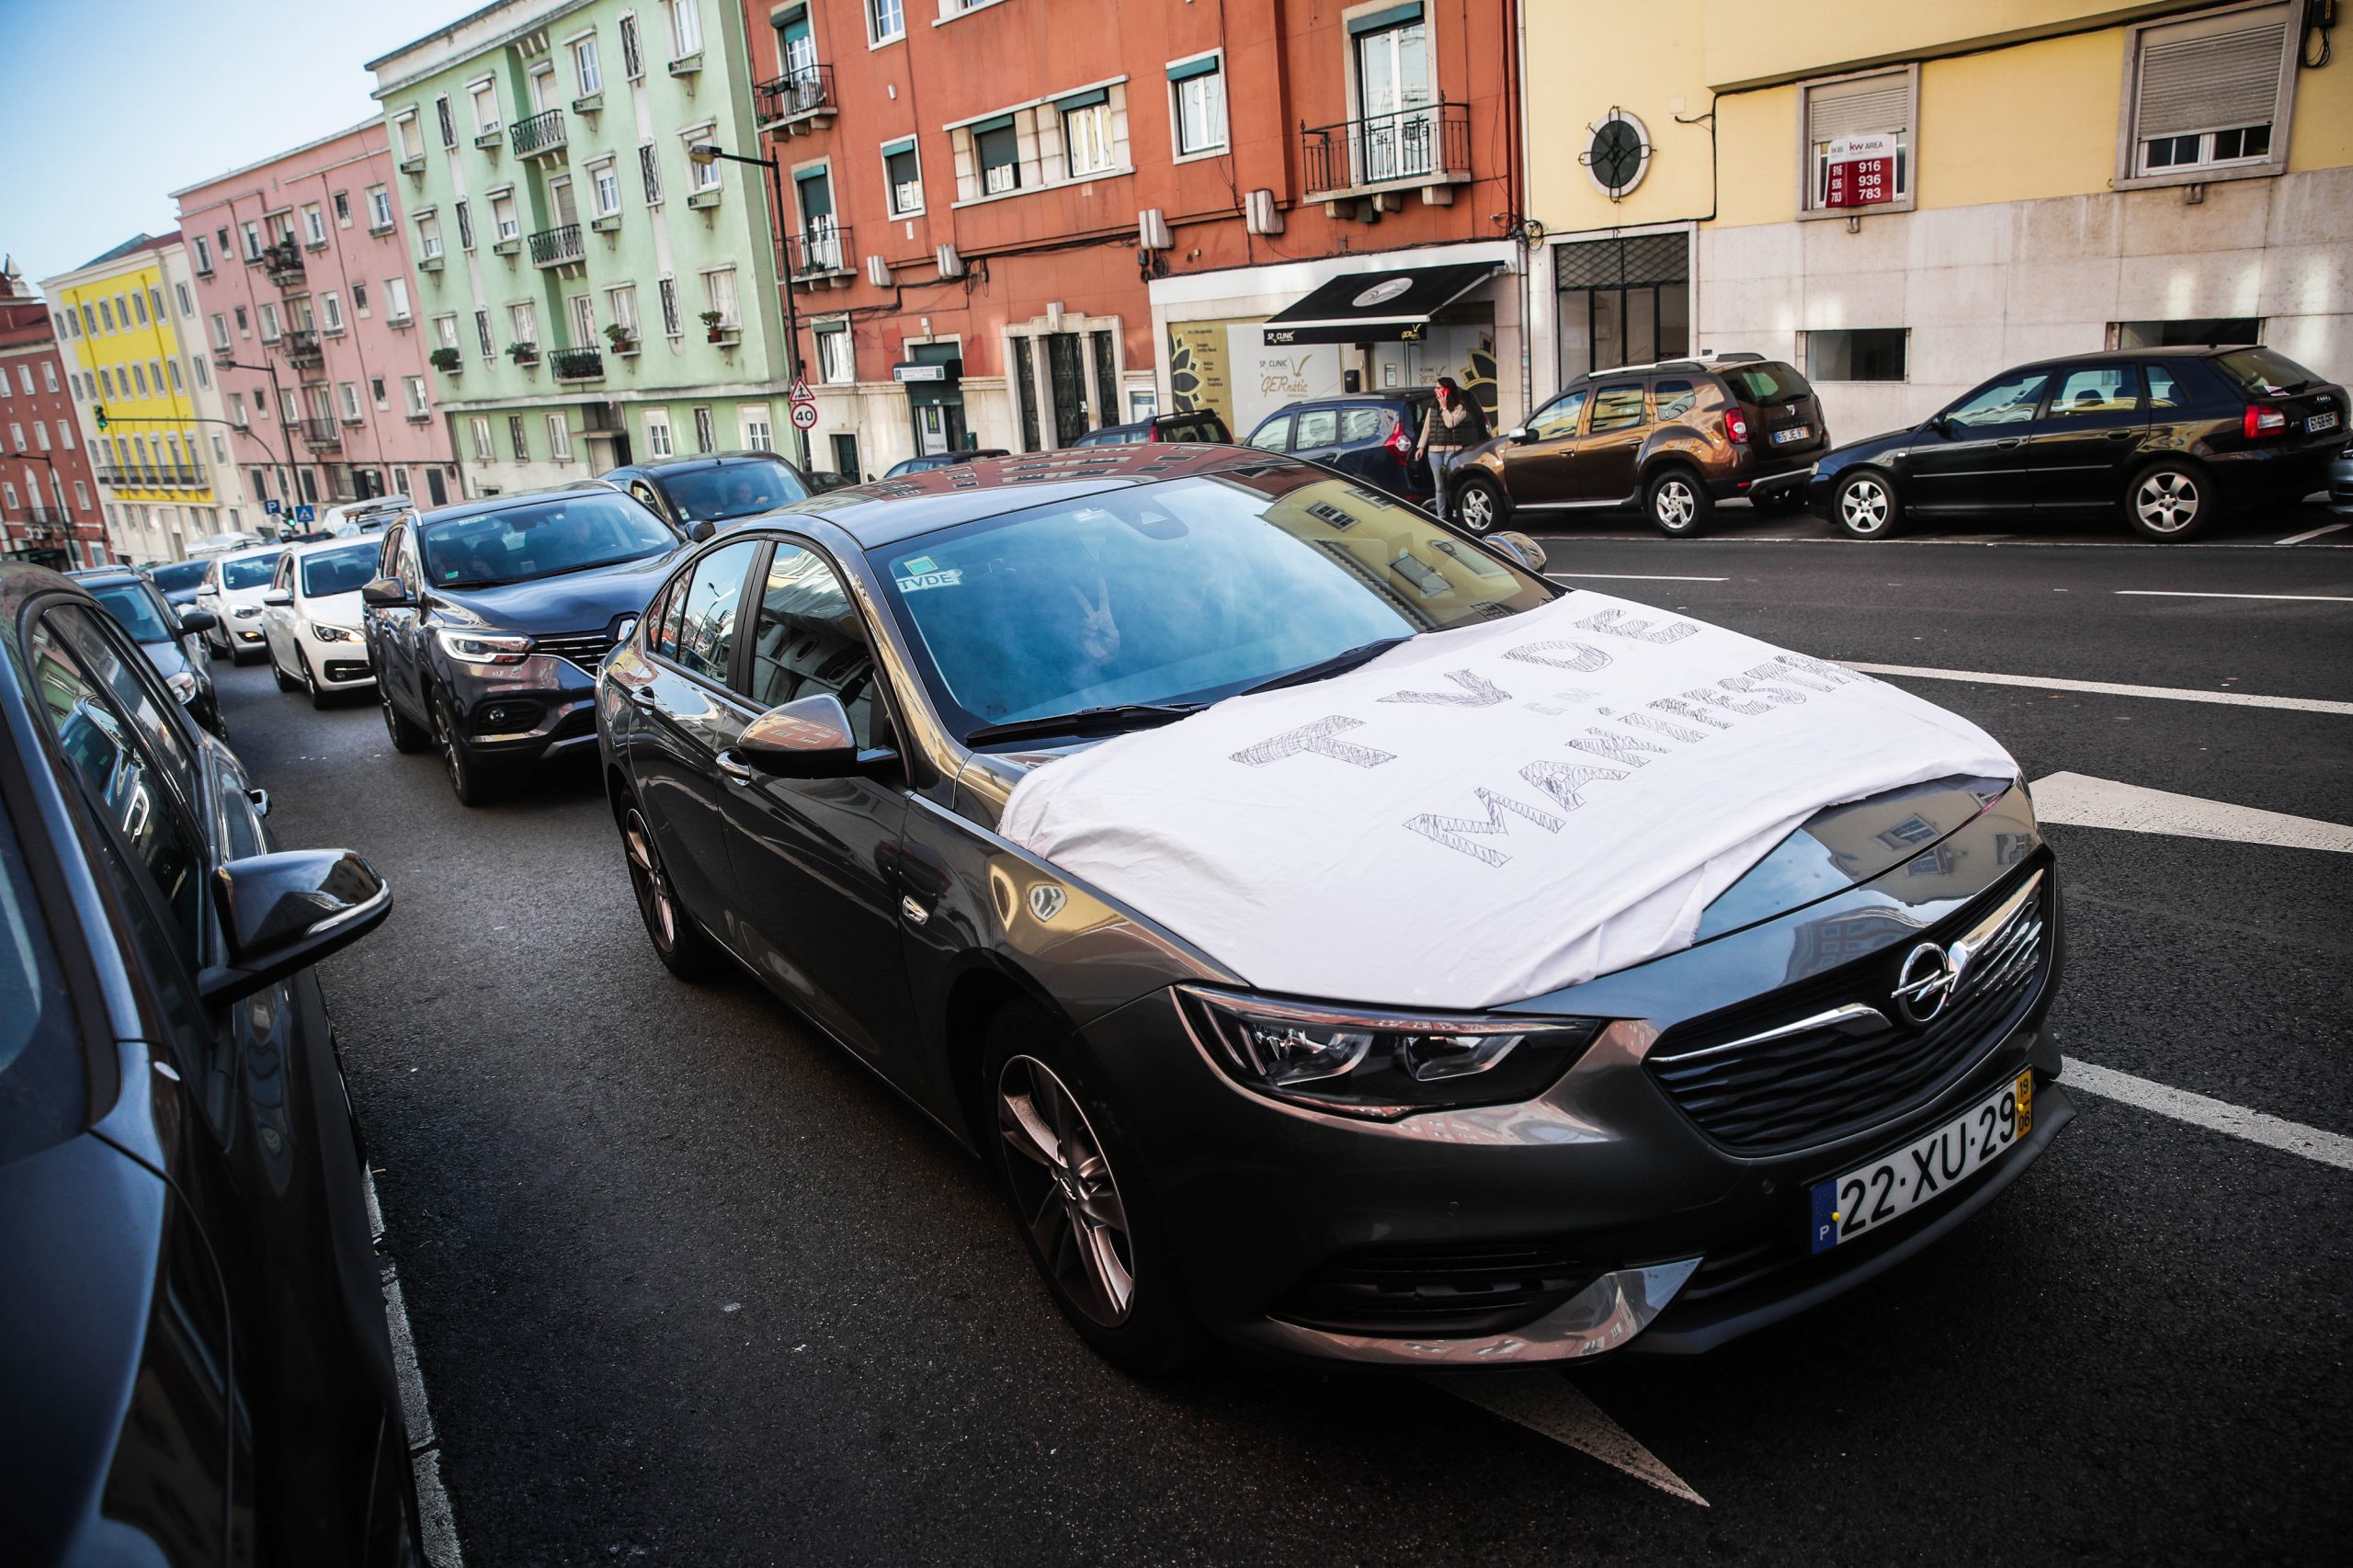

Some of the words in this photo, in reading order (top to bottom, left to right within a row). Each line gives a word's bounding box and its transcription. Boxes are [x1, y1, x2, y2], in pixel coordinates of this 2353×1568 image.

[1849, 142, 1863, 151] kw
[1865, 142, 1883, 150] AREA
[1859, 160, 1881, 172] 916
[1859, 175, 1881, 187] 936
[1859, 187, 1881, 199] 783
[795, 411, 813, 421] 40
[897, 574, 954, 589] TVDE
[1227, 608, 1702, 769] TVDE
[2020, 1078, 2029, 1098] 19
[2018, 1110, 2030, 1131] 06
[1819, 1224, 1830, 1241] P
